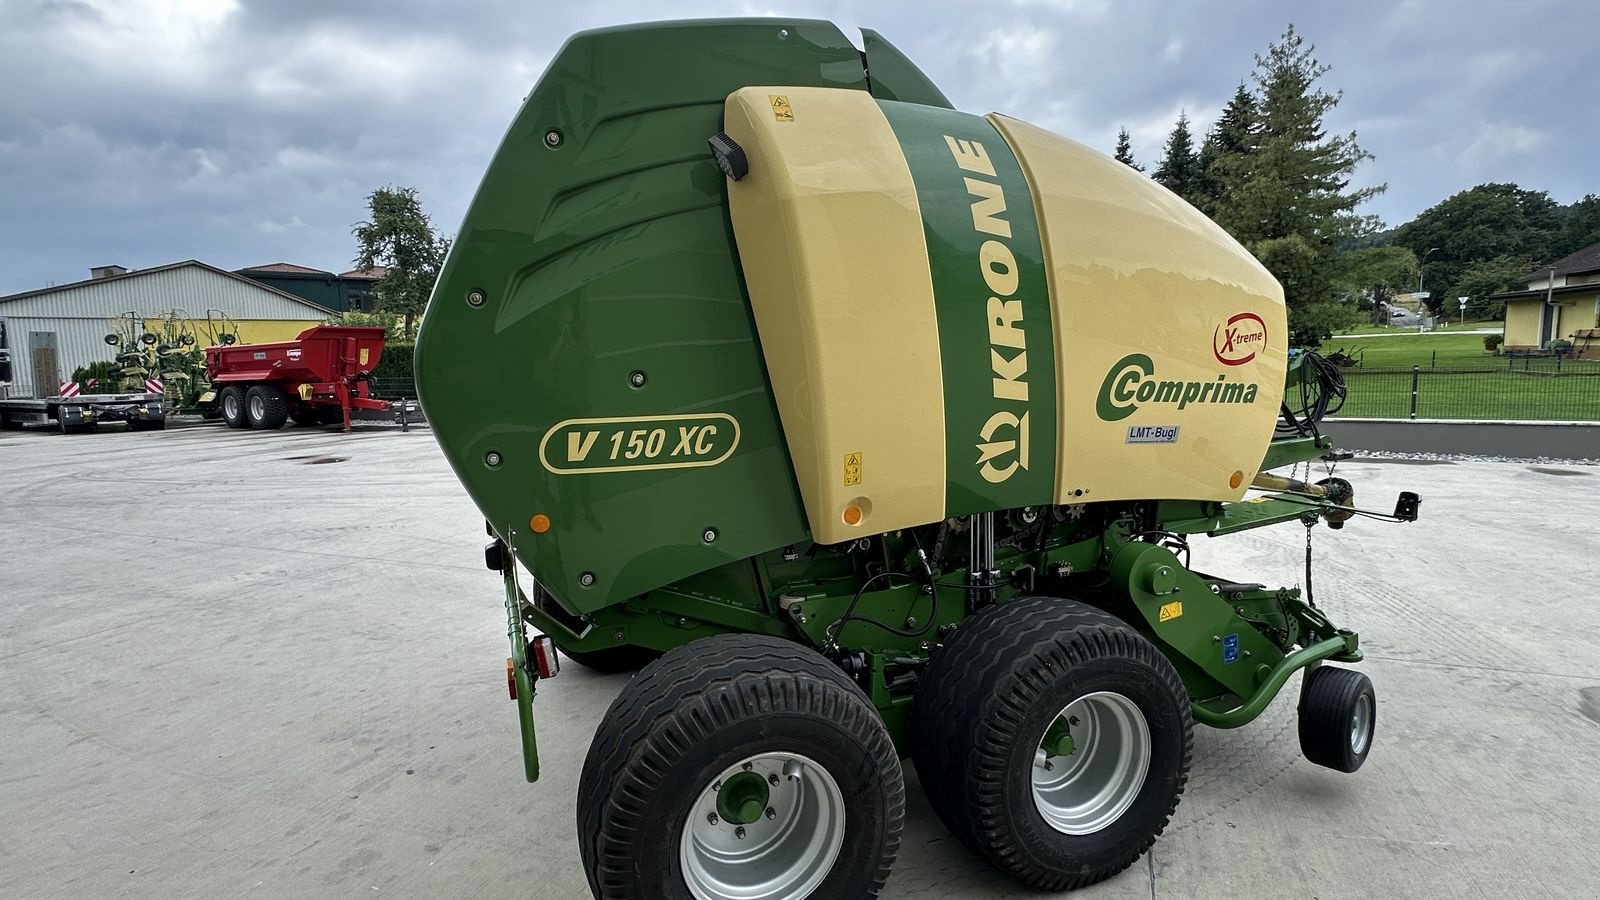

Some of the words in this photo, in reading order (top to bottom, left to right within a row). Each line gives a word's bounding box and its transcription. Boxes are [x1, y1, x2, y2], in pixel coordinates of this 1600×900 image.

[943, 135, 1029, 401] KRONE
[1220, 328, 1263, 353] X-treme
[568, 431, 600, 462] V
[609, 429, 666, 460] 150
[670, 425, 717, 456] XC
